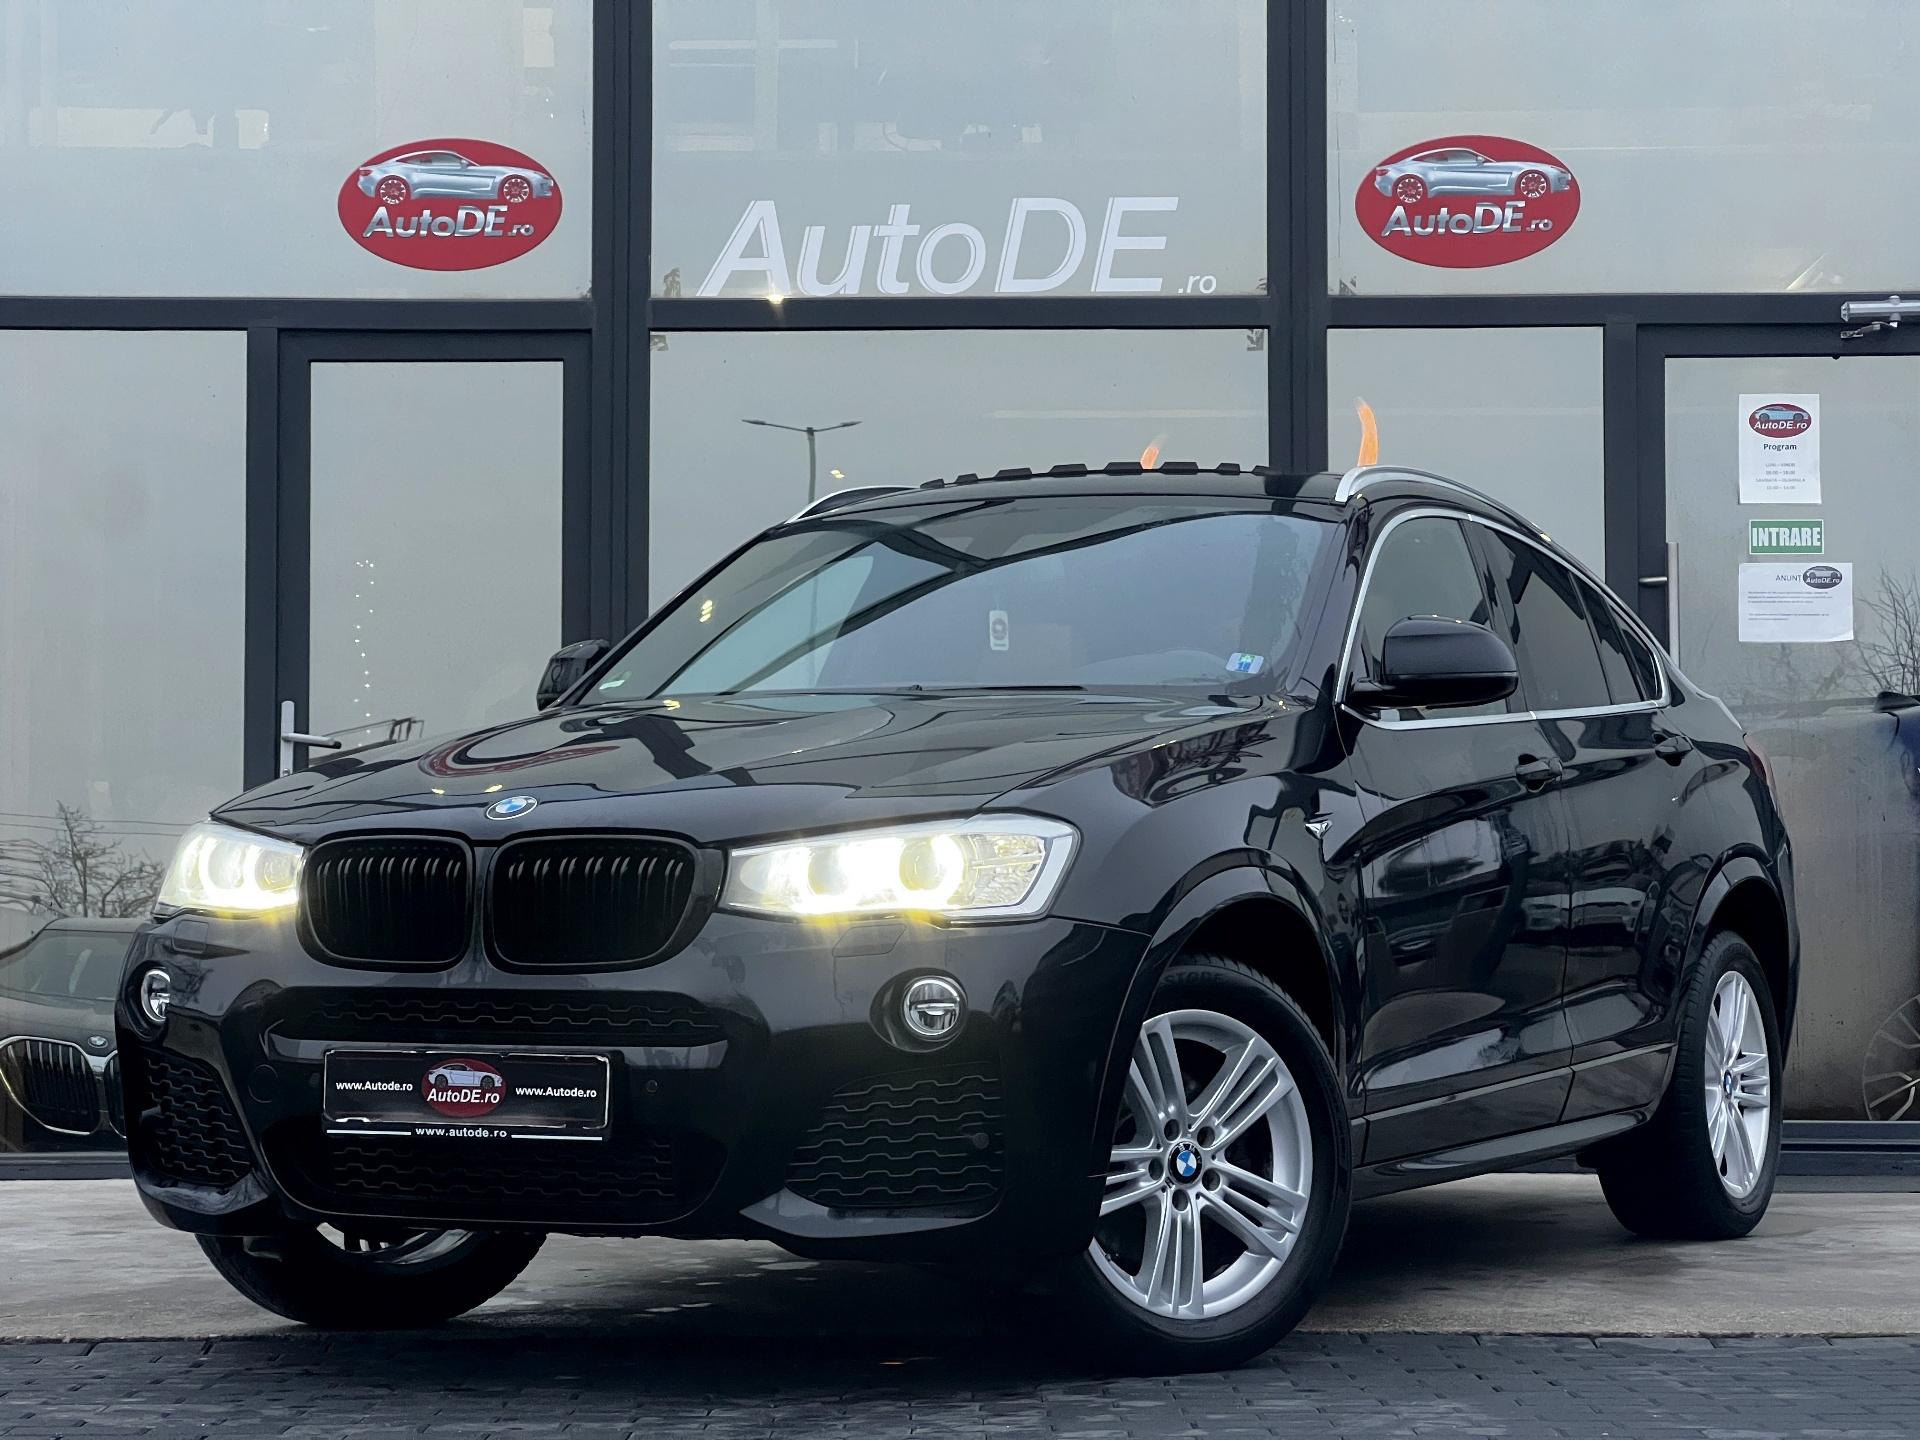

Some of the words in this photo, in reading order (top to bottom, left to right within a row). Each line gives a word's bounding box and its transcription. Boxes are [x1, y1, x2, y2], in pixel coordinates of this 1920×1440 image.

[1754, 420, 1807, 429] AutoDE.ro
[1763, 443, 1797, 451] Program
[1752, 527, 1821, 547] INTRARE
[335, 1081, 414, 1092] www.Autode.ro
[427, 1088, 500, 1104] AutoDE.ro
[515, 1087, 598, 1098] www.Autode.ro
[415, 1127, 508, 1138] www.autode.ro
